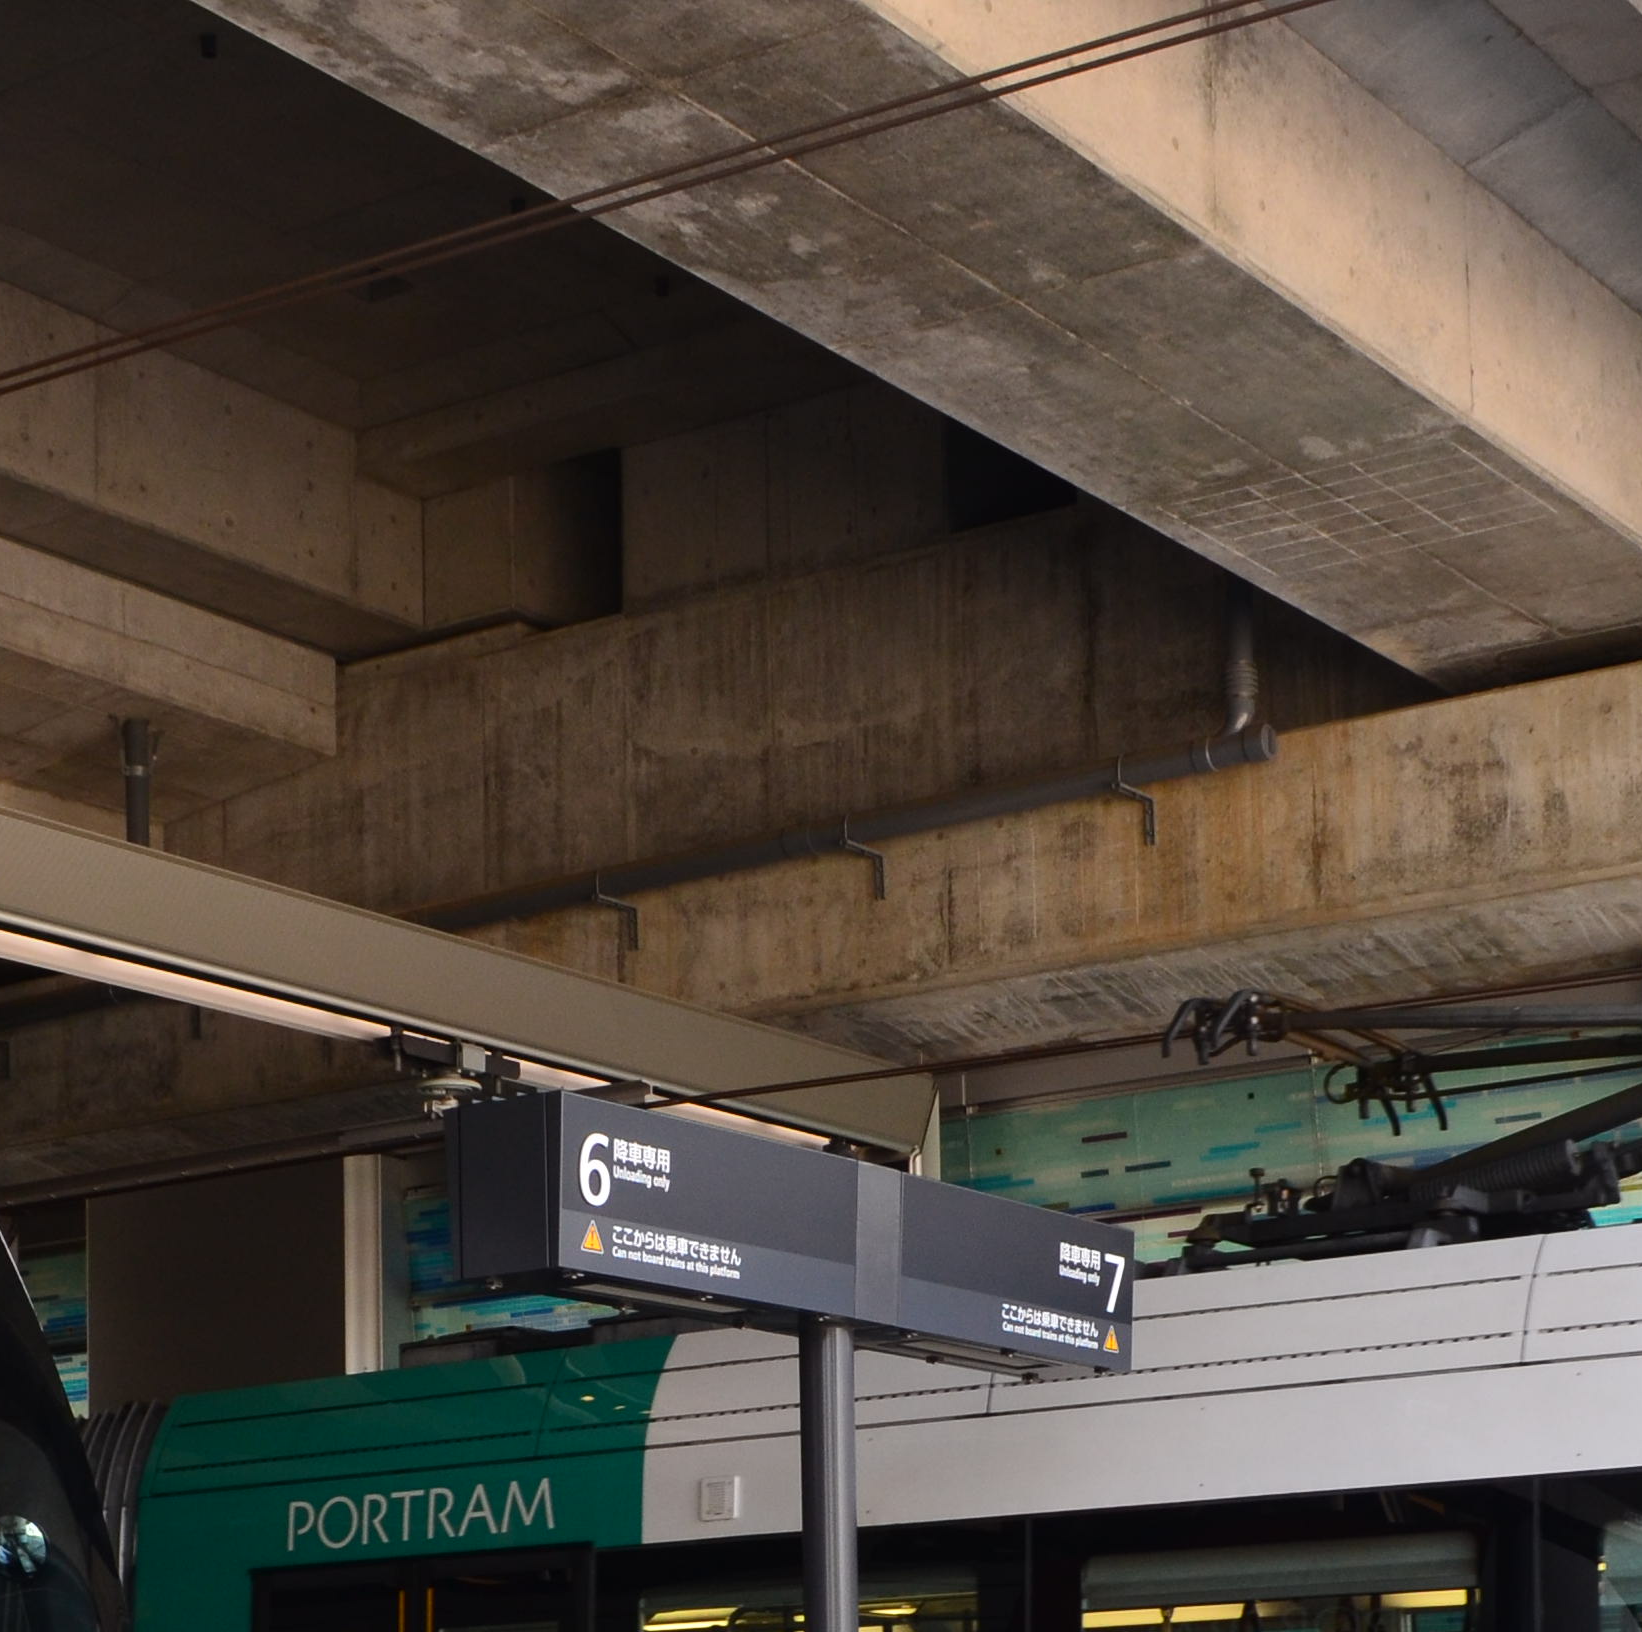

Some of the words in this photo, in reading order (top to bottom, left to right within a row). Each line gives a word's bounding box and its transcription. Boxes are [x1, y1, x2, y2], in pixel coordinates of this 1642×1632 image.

[579, 1132, 611, 1207] 6
[613, 1138, 671, 1174] 降車専用
[613, 1164, 652, 1188] Unloading
[653, 1173, 671, 1192] only
[612, 1225, 742, 1266] ここからは乗車できません
[612, 1246, 627, 1259] Can
[628, 1250, 641, 1262] not
[642, 1251, 664, 1265] board
[665, 1256, 685, 1269] trains
[686, 1260, 694, 1270] at
[695, 1261, 709, 1274] this
[710, 1264, 740, 1279] platform
[1059, 1241, 1101, 1271] 降車専用
[1059, 1264, 1087, 1284] Unloading
[1088, 1272, 1100, 1287] only
[1104, 1252, 1125, 1313] 7
[1001, 1303, 1099, 1338] ここからは乗車できません
[1002, 1320, 1013, 1332] Can
[1014, 1324, 1024, 1335] not
[1025, 1325, 1041, 1338] board
[1042, 1329, 1057, 1341] trains
[1058, 1333, 1064, 1343] at
[1065, 1333, 1075, 1345] this
[1075, 1337, 1099, 1350] platform
[287, 1477, 556, 1552] PORTRAM
